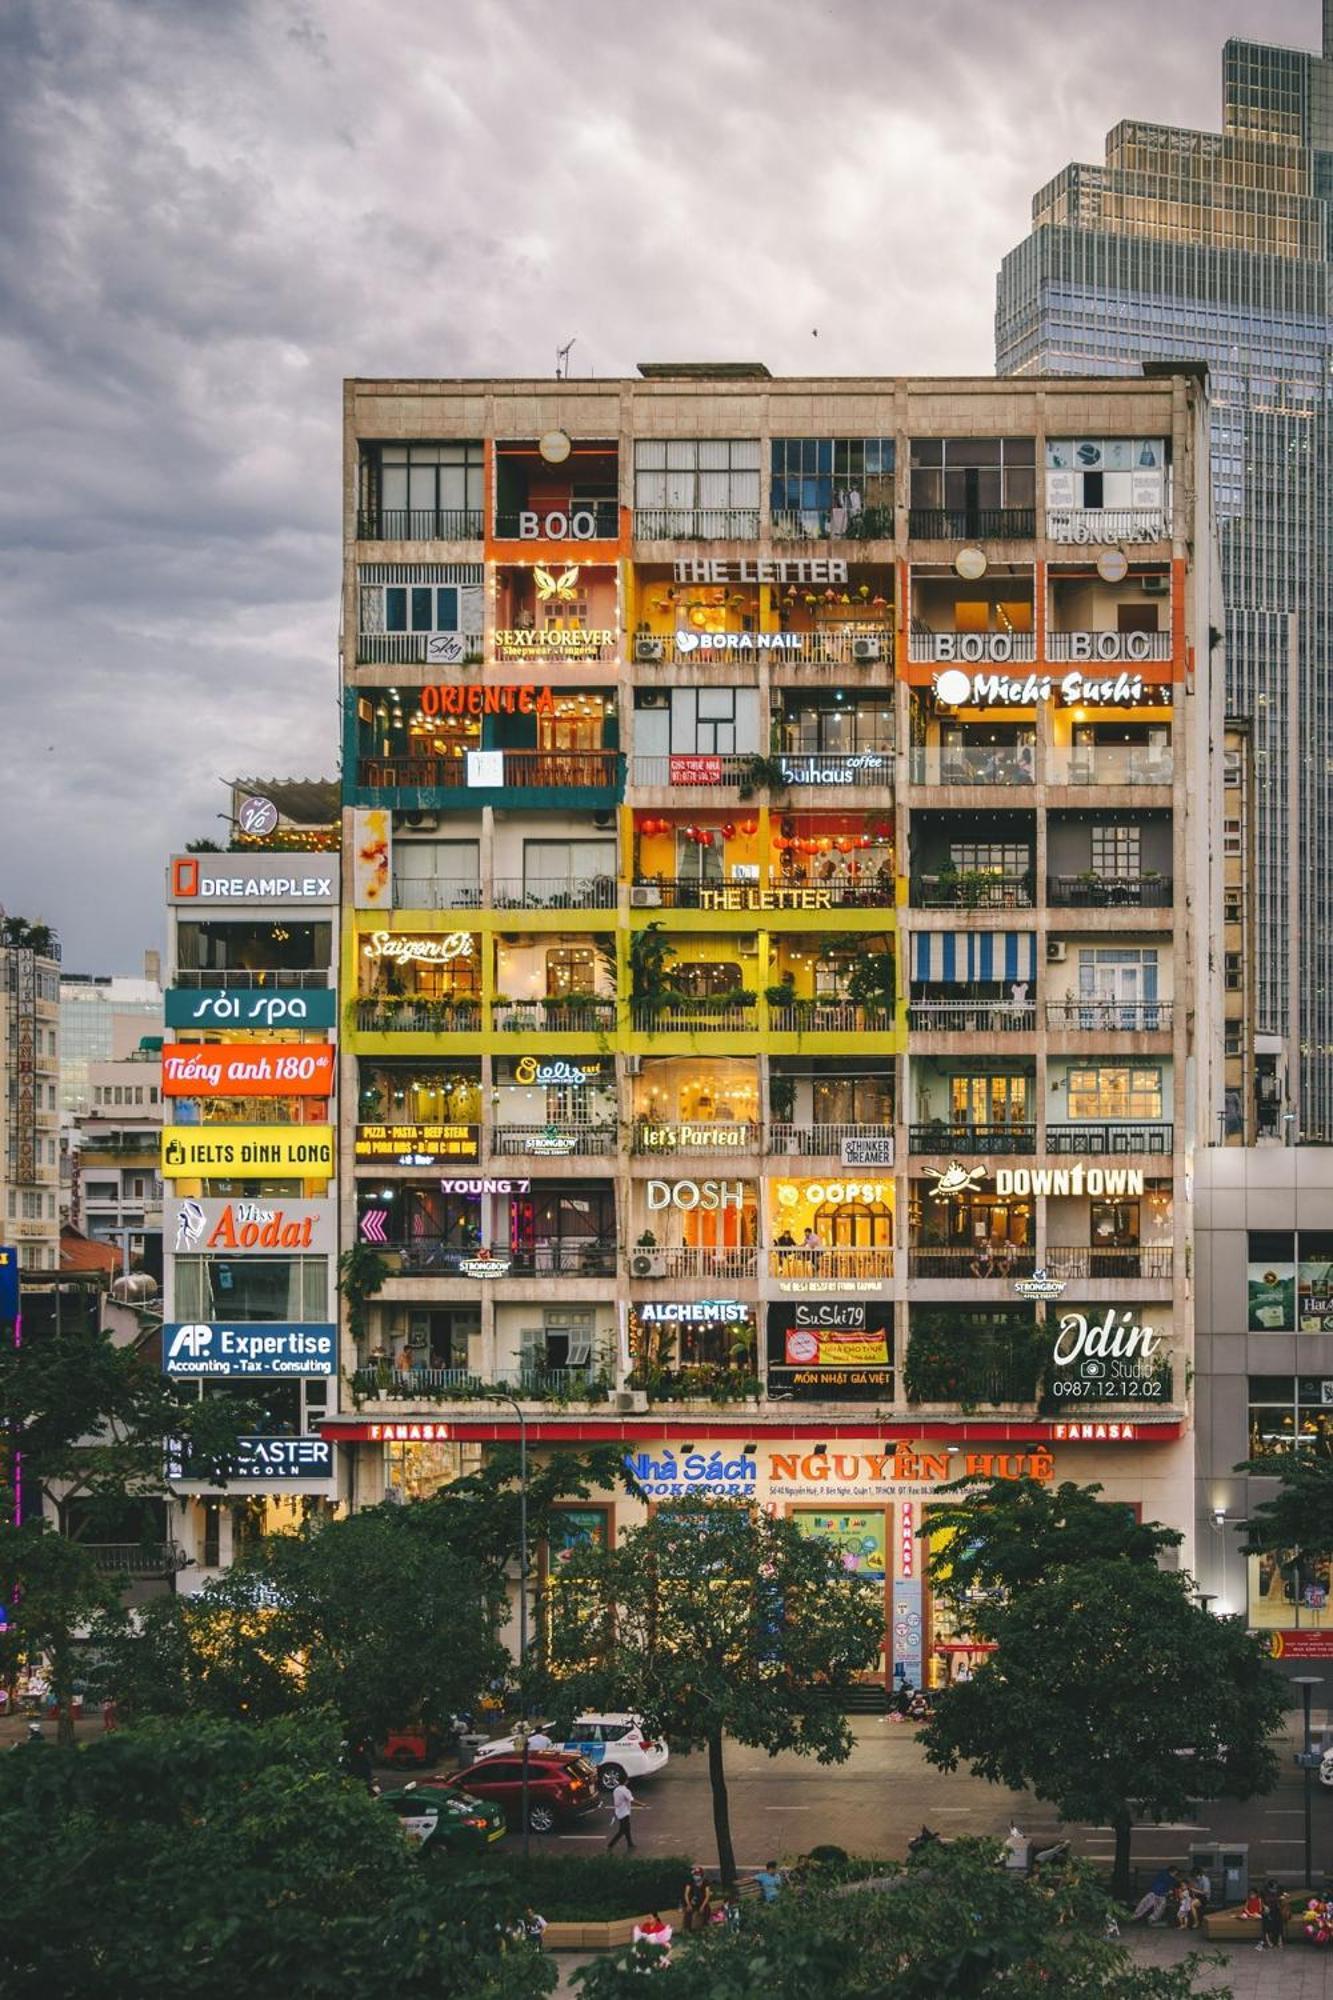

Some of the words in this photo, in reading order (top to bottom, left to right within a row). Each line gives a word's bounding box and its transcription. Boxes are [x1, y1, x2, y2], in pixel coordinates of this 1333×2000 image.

[519, 511, 596, 540] BOO
[675, 558, 729, 583] THE
[740, 558, 848, 583] LETTER
[495, 630, 536, 645] SEXY
[540, 631, 614, 645] FOREVER
[699, 635, 752, 648] BORA
[758, 635, 802, 648] NAIL
[936, 633, 1012, 661] BOO
[973, 672, 1050, 703] Michi
[1061, 671, 1142, 701] Sushi
[421, 684, 557, 715] ORIENTEA
[846, 755, 882, 768] coffee
[201, 879, 331, 896] DREAMPLEX
[701, 890, 741, 909] THE
[749, 890, 831, 909] LETTER
[364, 931, 447, 965] Saigon
[249, 998, 306, 1024] spa
[165, 1054, 221, 1087] Tiếng
[228, 1058, 272, 1080] anh
[526, 1139, 577, 1148] STRONGBOW
[191, 1145, 234, 1162] IELTS
[288, 1145, 331, 1162] LONG
[441, 1180, 511, 1193] YOUNG
[519, 1180, 529, 1193] 7
[647, 1180, 743, 1210] DOSH
[806, 1183, 882, 1204] OOPS!
[237, 1203, 276, 1223] Miss
[459, 1261, 512, 1271] STRONGBOW
[1014, 1282, 1067, 1292] STRONGBOW
[641, 1304, 748, 1321] ALCHEMIST
[221, 1331, 331, 1359] Expertise
[1054, 1309, 1161, 1366] Odin
[167, 1360, 231, 1374] Accounting
[240, 1360, 262, 1372] Tax
[272, 1360, 331, 1374] Consulting
[1111, 1360, 1153, 1378] Studio
[1053, 1381, 1162, 1397] 0987.12.12.02
[371, 1425, 448, 1439] FAHASA
[1056, 1424, 1133, 1439] FAHASA
[624, 1450, 677, 1480] Nhà
[684, 1450, 756, 1480] Sách
[769, 1440, 949, 1481] NGUYỄN
[902, 1502, 912, 1577] FAHASA
